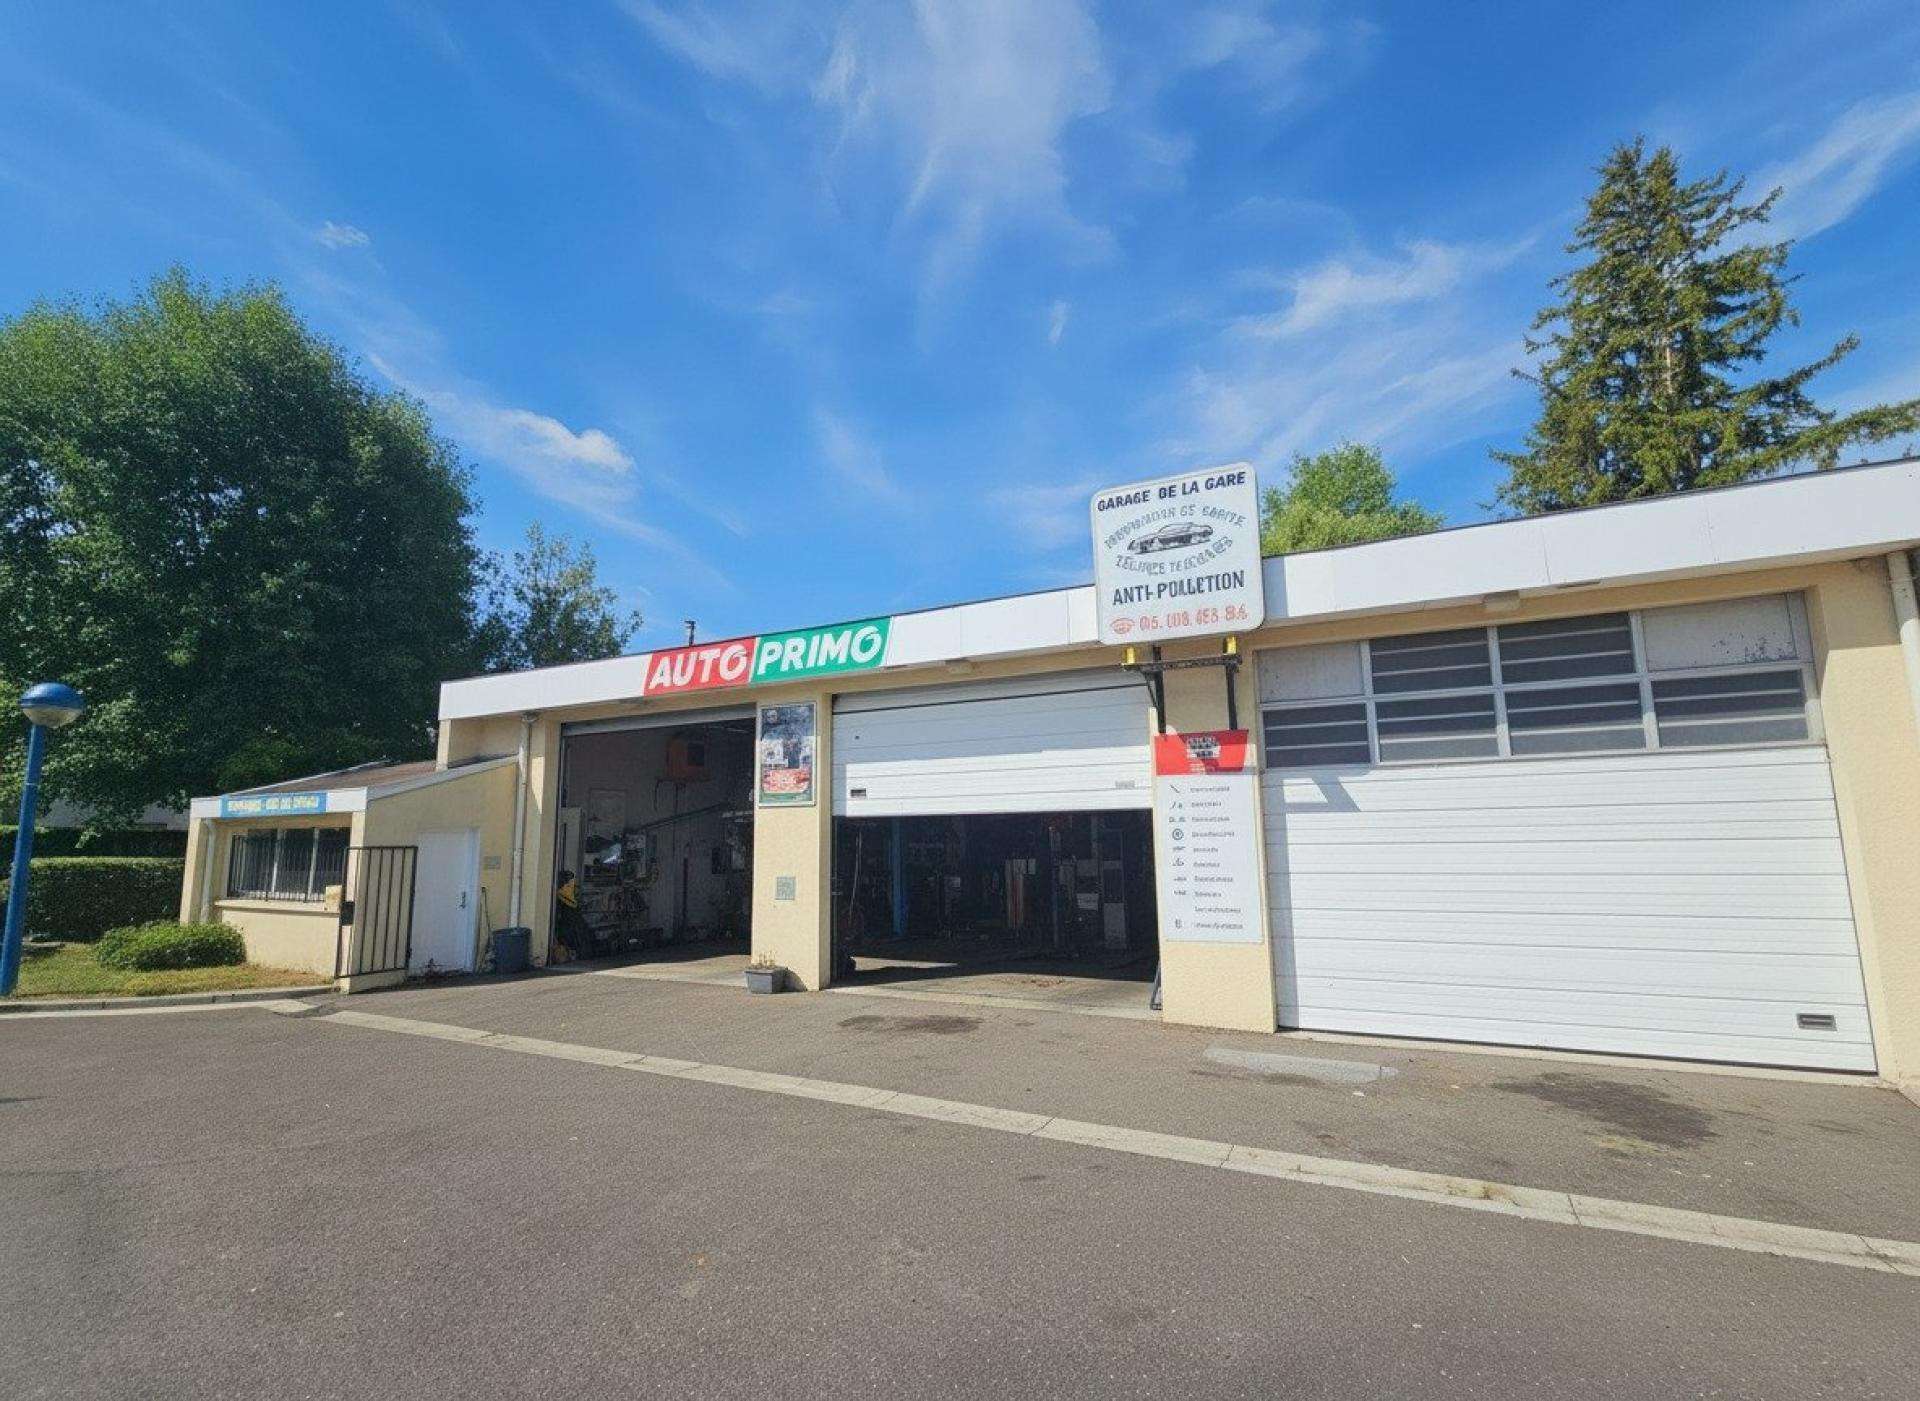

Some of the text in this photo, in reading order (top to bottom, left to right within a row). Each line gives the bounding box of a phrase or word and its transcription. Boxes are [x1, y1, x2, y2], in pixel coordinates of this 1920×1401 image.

[1097, 489, 1151, 512] GARAGE
[1181, 480, 1200, 496] LA
[1204, 471, 1246, 491] GARE
[648, 625, 883, 690] AUTO PRIMO
